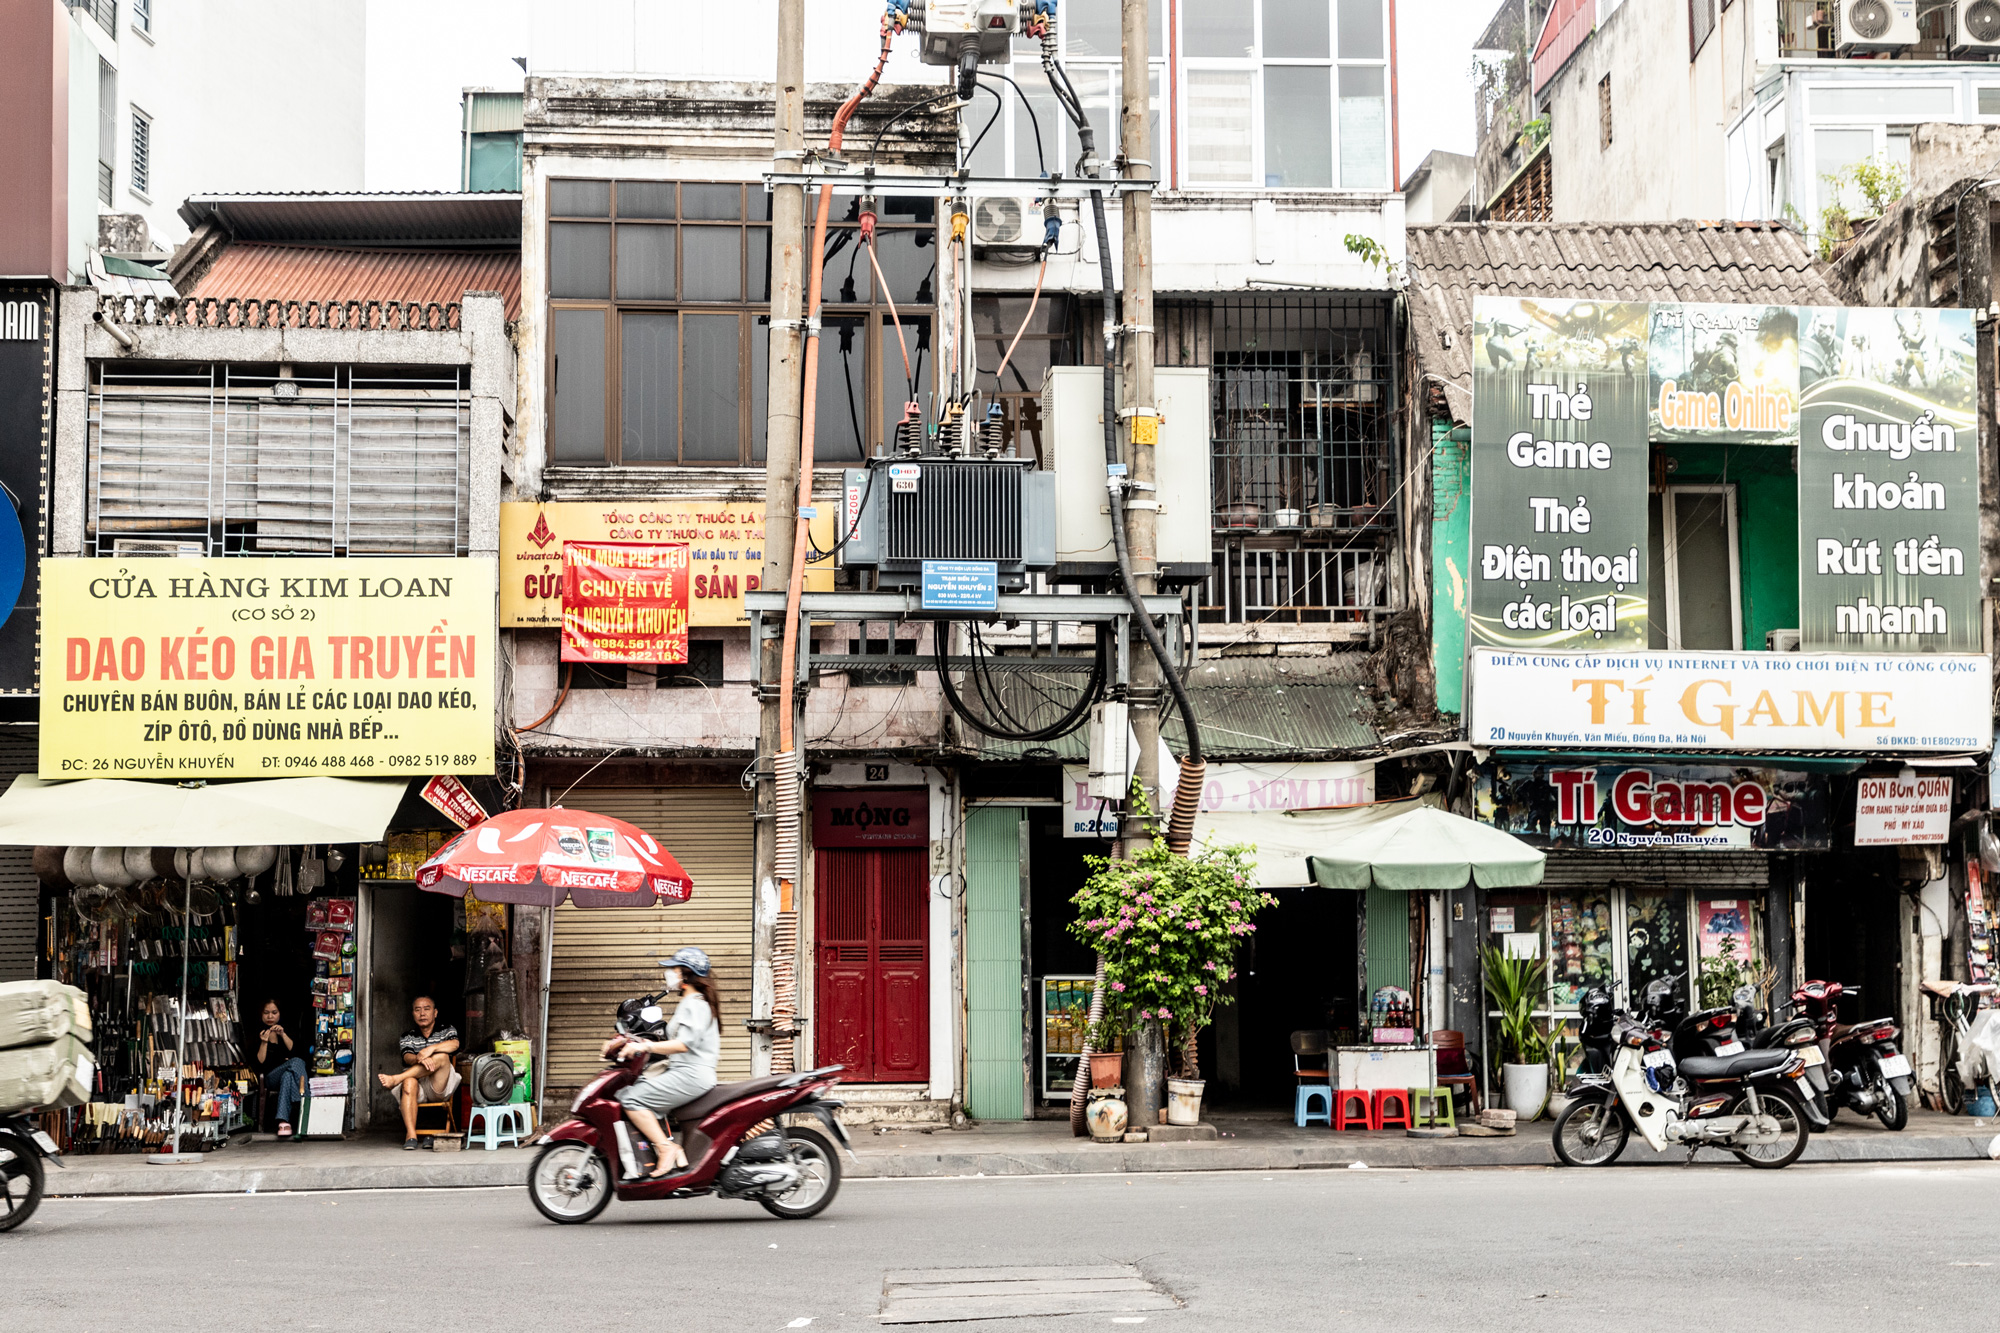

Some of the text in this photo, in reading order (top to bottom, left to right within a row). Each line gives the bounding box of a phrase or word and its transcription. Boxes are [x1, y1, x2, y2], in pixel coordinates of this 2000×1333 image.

[1656, 309, 1759, 335] Tí GAME
[1526, 382, 1593, 421] Thẻ
[1660, 380, 1790, 430] Game Online
[1821, 409, 1956, 460] Chuyển
[1506, 432, 1612, 470] Game
[896, 481, 914, 490] 630
[1832, 471, 1947, 511] khoản
[603, 509, 634, 524] TỔNG
[639, 511, 672, 524] CÔNG
[678, 513, 692, 524] TY
[696, 510, 736, 524] THUỐC
[741, 511, 756, 524] LÁ
[1529, 495, 1592, 535] Thẻ
[610, 527, 766, 542] CÔNG TY THƯƠNG MẠI THU
[567, 544, 687, 572] THU MUA PHẾ LIỆU
[1481, 544, 1639, 592] Điện thoại
[1817, 534, 1965, 577] Rút tiền
[89, 568, 452, 598] CỬA HÀNG KIM LOAN
[579, 572, 673, 598] CHUYỂN VỀ
[694, 564, 738, 598] SẢN
[231, 603, 316, 622] (CƠ SỞ 2)
[583, 598, 633, 634] NGUYỄN
[637, 600, 686, 636] KHUYẾN
[1502, 593, 1616, 640] các loại
[1836, 597, 1947, 635] nhanh
[66, 619, 476, 682] DAO KÉO GIA TRUYỀN
[569, 638, 680, 650] LH: 0984.561.072
[592, 650, 680, 662] 0984.322.164
[1491, 653, 1528, 667] ĐIỂM
[1532, 656, 1570, 668] CUNG
[1575, 654, 1600, 668] CẤP
[1606, 658, 1639, 670] DỊCH
[1644, 658, 1663, 672] VỤ
[1668, 659, 1738, 670] INTERNET
[1742, 660, 1759, 670] VÀ
[1765, 659, 1791, 670] TRÒ
[1796, 660, 1830, 671] CHƠI
[1835, 660, 1869, 674] ĐIỆN
[1898, 660, 1935, 672] CÔNG
[1940, 660, 1977, 674] CỘNG
[63, 684, 478, 714] CHUYÊN BÁN BUÔN, BÁN LẺ CÁC LOẠI DAO KÉO,
[1572, 674, 1896, 740] Tí GAME
[144, 714, 400, 744] ZÍP ÔTÔ, ĐỒ DÙNG NHÀ BẾP...
[1490, 726, 1706, 746] 20 Nguyễn Khuyến, Văn Miếu, Đống Đa, Hà Nội
[1876, 734, 1978, 746] Số ĐKKD: 01E8029733
[61, 751, 477, 771] ĐC: 26 NGUYỄN KHUYẾN ĐT: 0946 488 468 0982 519 889
[869, 767, 885, 780] 24
[1247, 779, 1310, 810] NEM
[1550, 769, 1767, 826] Tí Game
[1862, 782, 1886, 799] BON
[1917, 777, 1950, 800] QUÁN
[830, 801, 911, 831] MỘNG
[1861, 805, 1874, 814] CƠM
[1876, 805, 1892, 814] RANG
[1588, 828, 1729, 847] 20 Nguyễn Khuyến
[460, 862, 518, 882] NESCAFÉ
[560, 871, 620, 889] NESCAFÉ
[654, 878, 684, 898] NESCAFÉ
